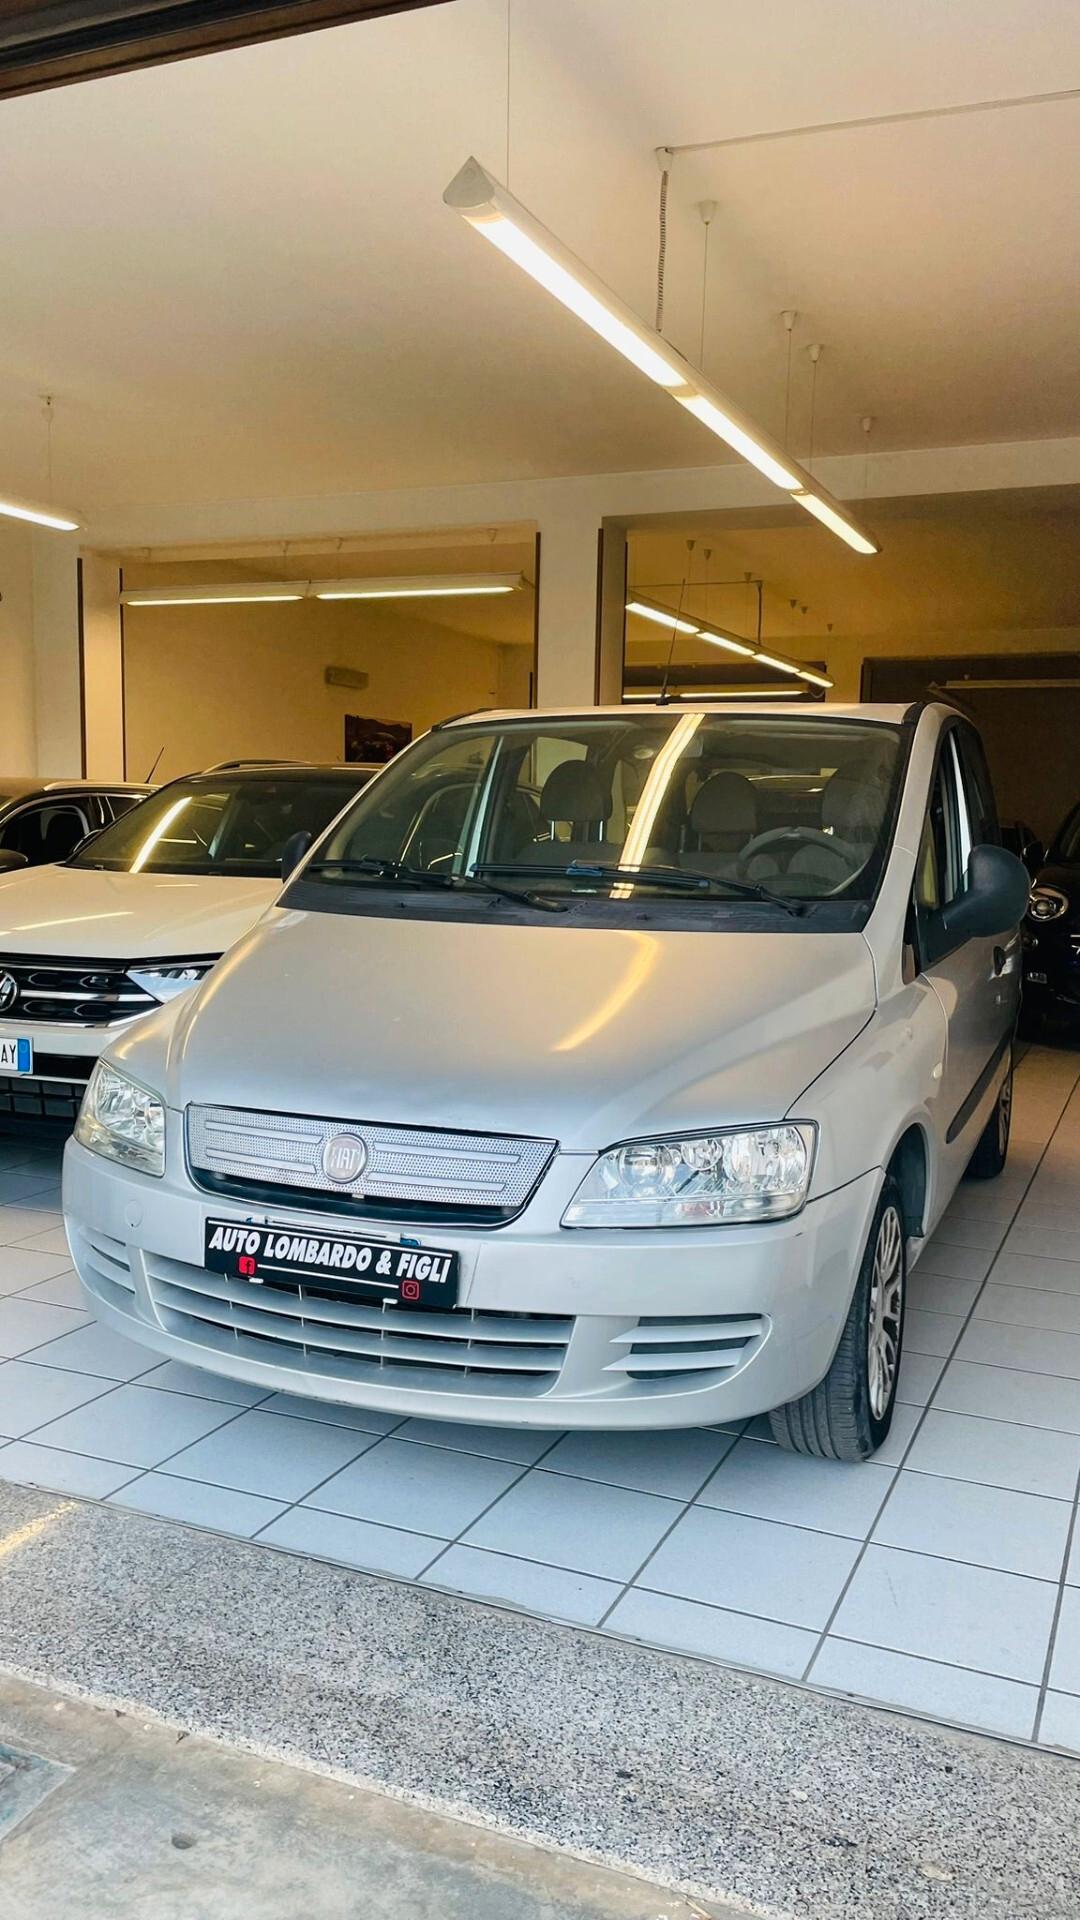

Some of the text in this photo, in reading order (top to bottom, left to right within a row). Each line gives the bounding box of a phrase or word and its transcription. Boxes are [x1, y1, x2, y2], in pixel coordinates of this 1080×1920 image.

[330, 1147, 360, 1169] FIAT
[208, 1226, 452, 1283] AUTO LOMBARDO & FIGLI
